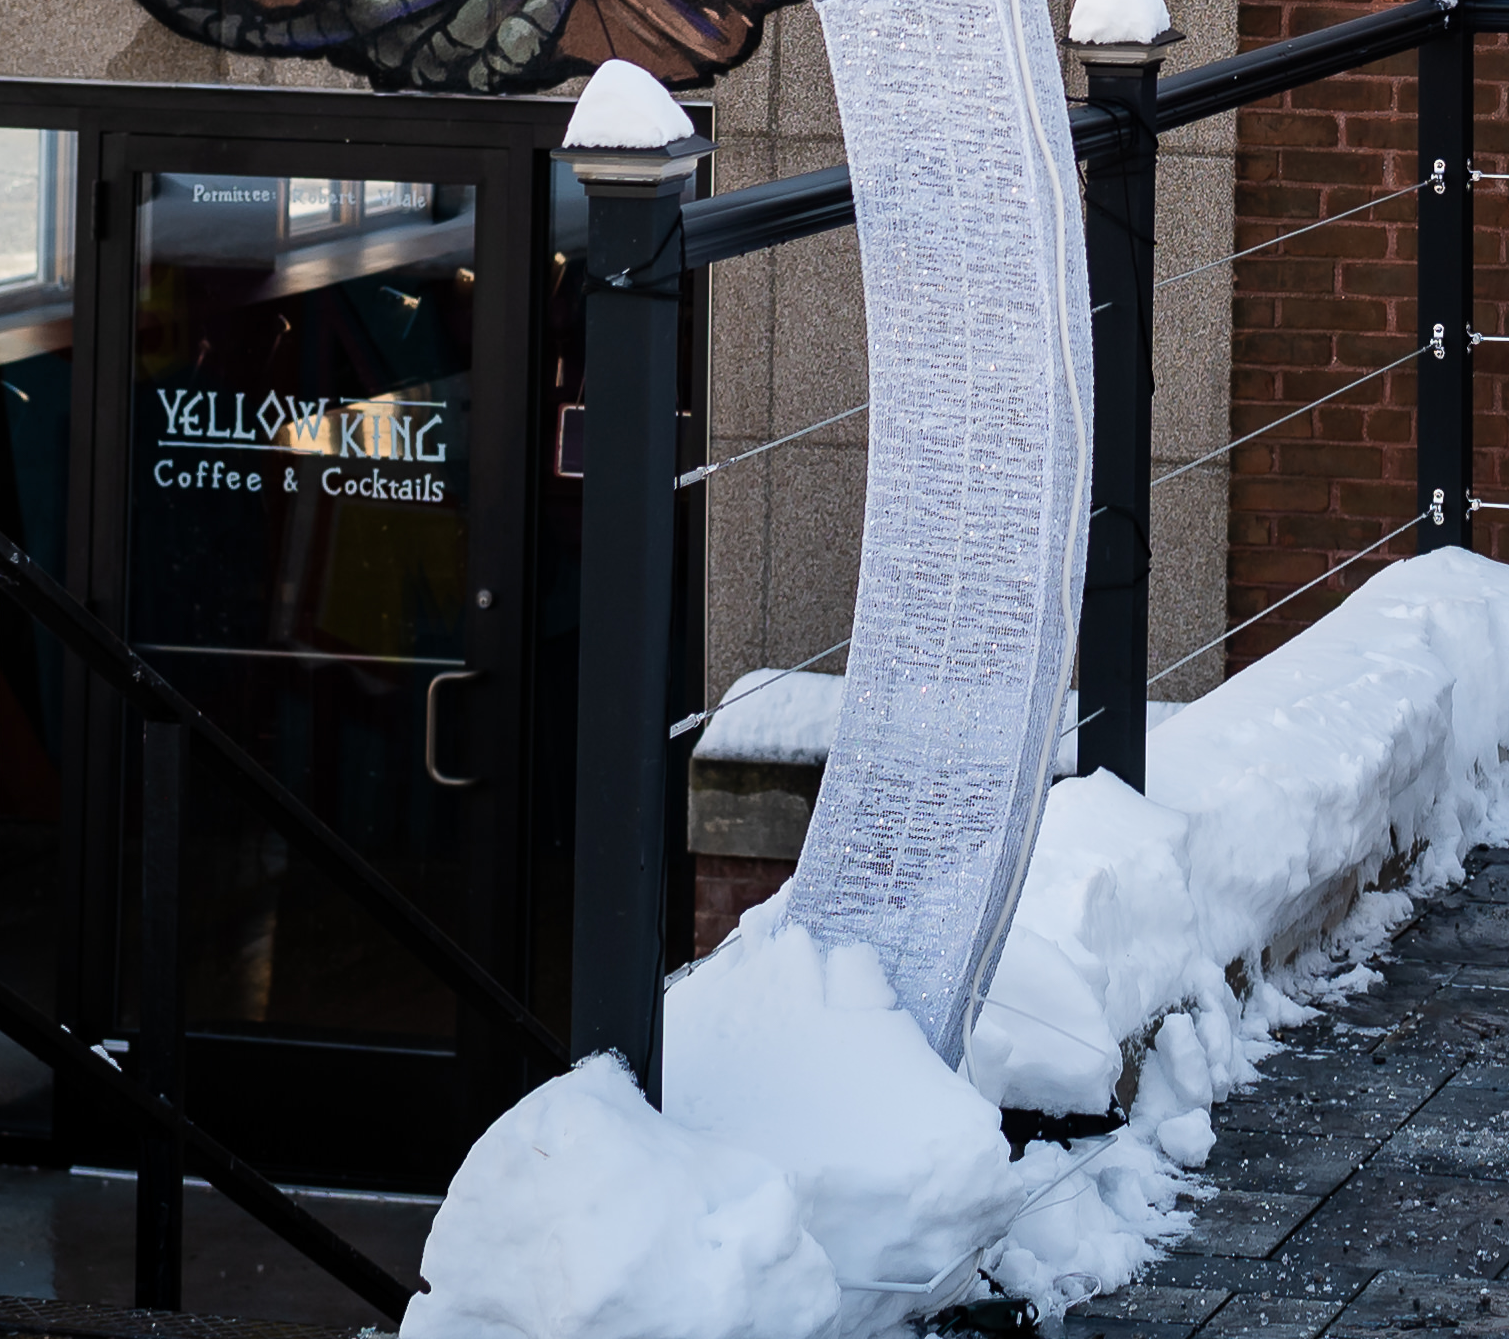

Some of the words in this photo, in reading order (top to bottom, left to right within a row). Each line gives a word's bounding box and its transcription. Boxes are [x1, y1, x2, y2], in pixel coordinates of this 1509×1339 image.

[292, 187, 356, 207] Robert
[157, 389, 329, 441] YELLOW
[339, 412, 447, 462] KING
[154, 459, 262, 492] Coffee
[283, 467, 299, 493] &
[321, 467, 445, 503] Cocktails
